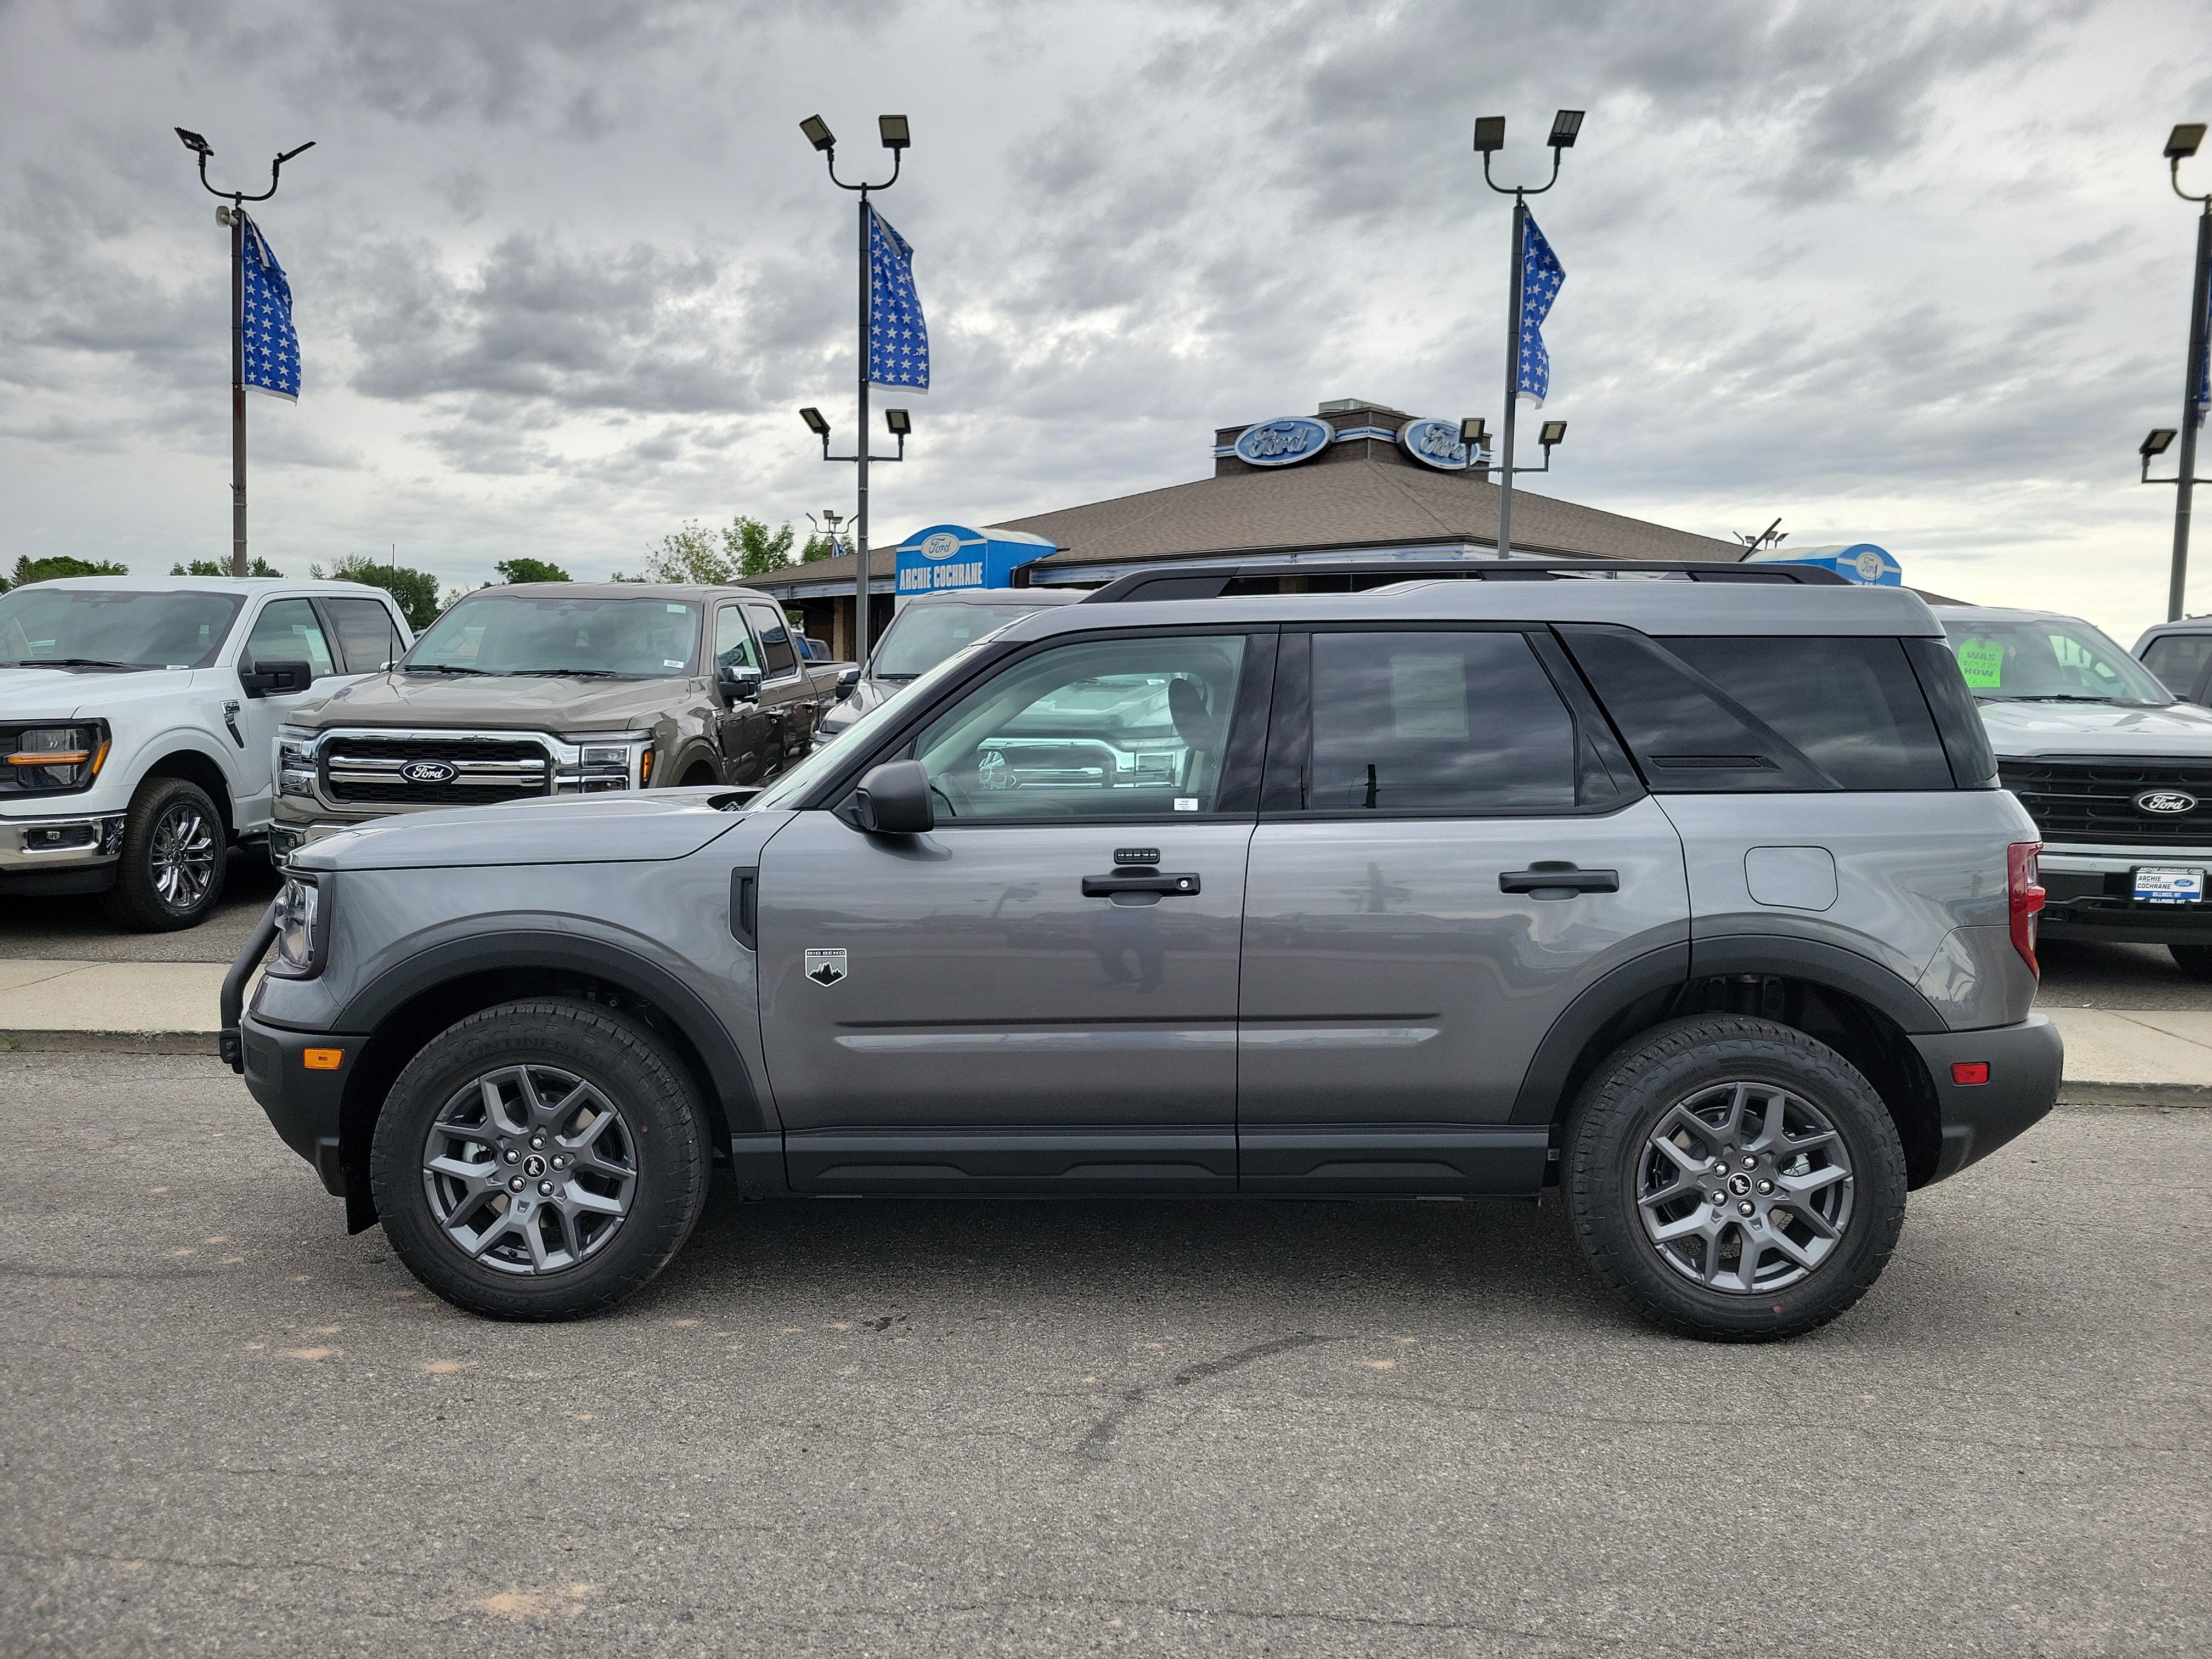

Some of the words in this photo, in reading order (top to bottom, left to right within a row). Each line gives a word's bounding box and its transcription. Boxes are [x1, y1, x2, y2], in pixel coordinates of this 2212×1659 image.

[1250, 422, 1310, 458] Ford
[929, 538, 951, 554] Ford
[1862, 556, 1877, 573] Ford
[900, 567, 931, 590] ARCHIE
[934, 562, 983, 587] COCHRANE
[1967, 652, 1996, 661] WAS
[1965, 668, 1994, 676] NOW
[413, 765, 444, 778] Ford
[2149, 795, 2185, 809] Ford
